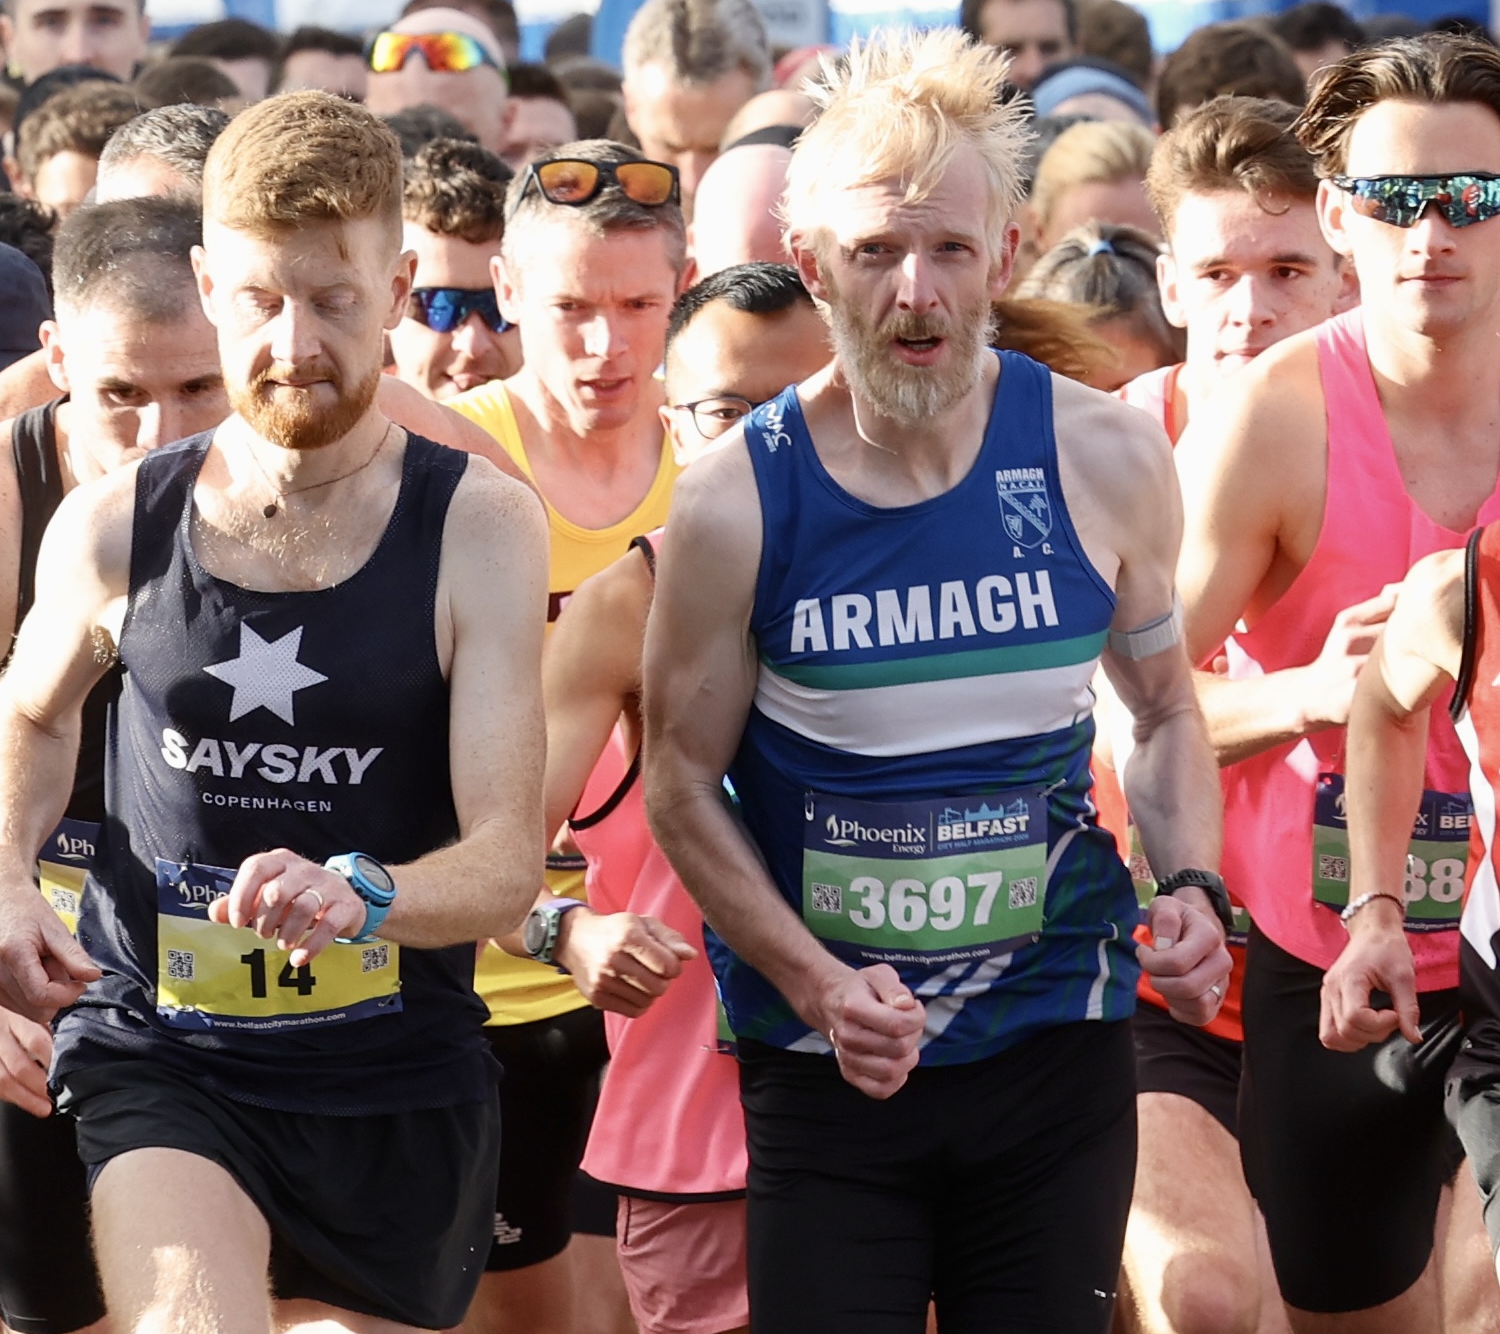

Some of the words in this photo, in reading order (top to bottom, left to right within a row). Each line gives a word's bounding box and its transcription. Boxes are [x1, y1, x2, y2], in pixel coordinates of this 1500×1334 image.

[995, 468, 1044, 481] ARMAGH
[790, 569, 1059, 653] ARMAGH
[160, 727, 385, 786] SAYSKY
[201, 792, 333, 813] COPENHAGEN
[840, 819, 926, 843] Phoenix
[936, 814, 1030, 843] BELFAST
[892, 843, 926, 854] Energy
[849, 870, 1003, 932] 3697
[861, 948, 991, 965] www.belfastcitymarathon.com
[241, 948, 316, 999] 14
[213, 1011, 347, 1031] www.belfastcitymarathon.com
